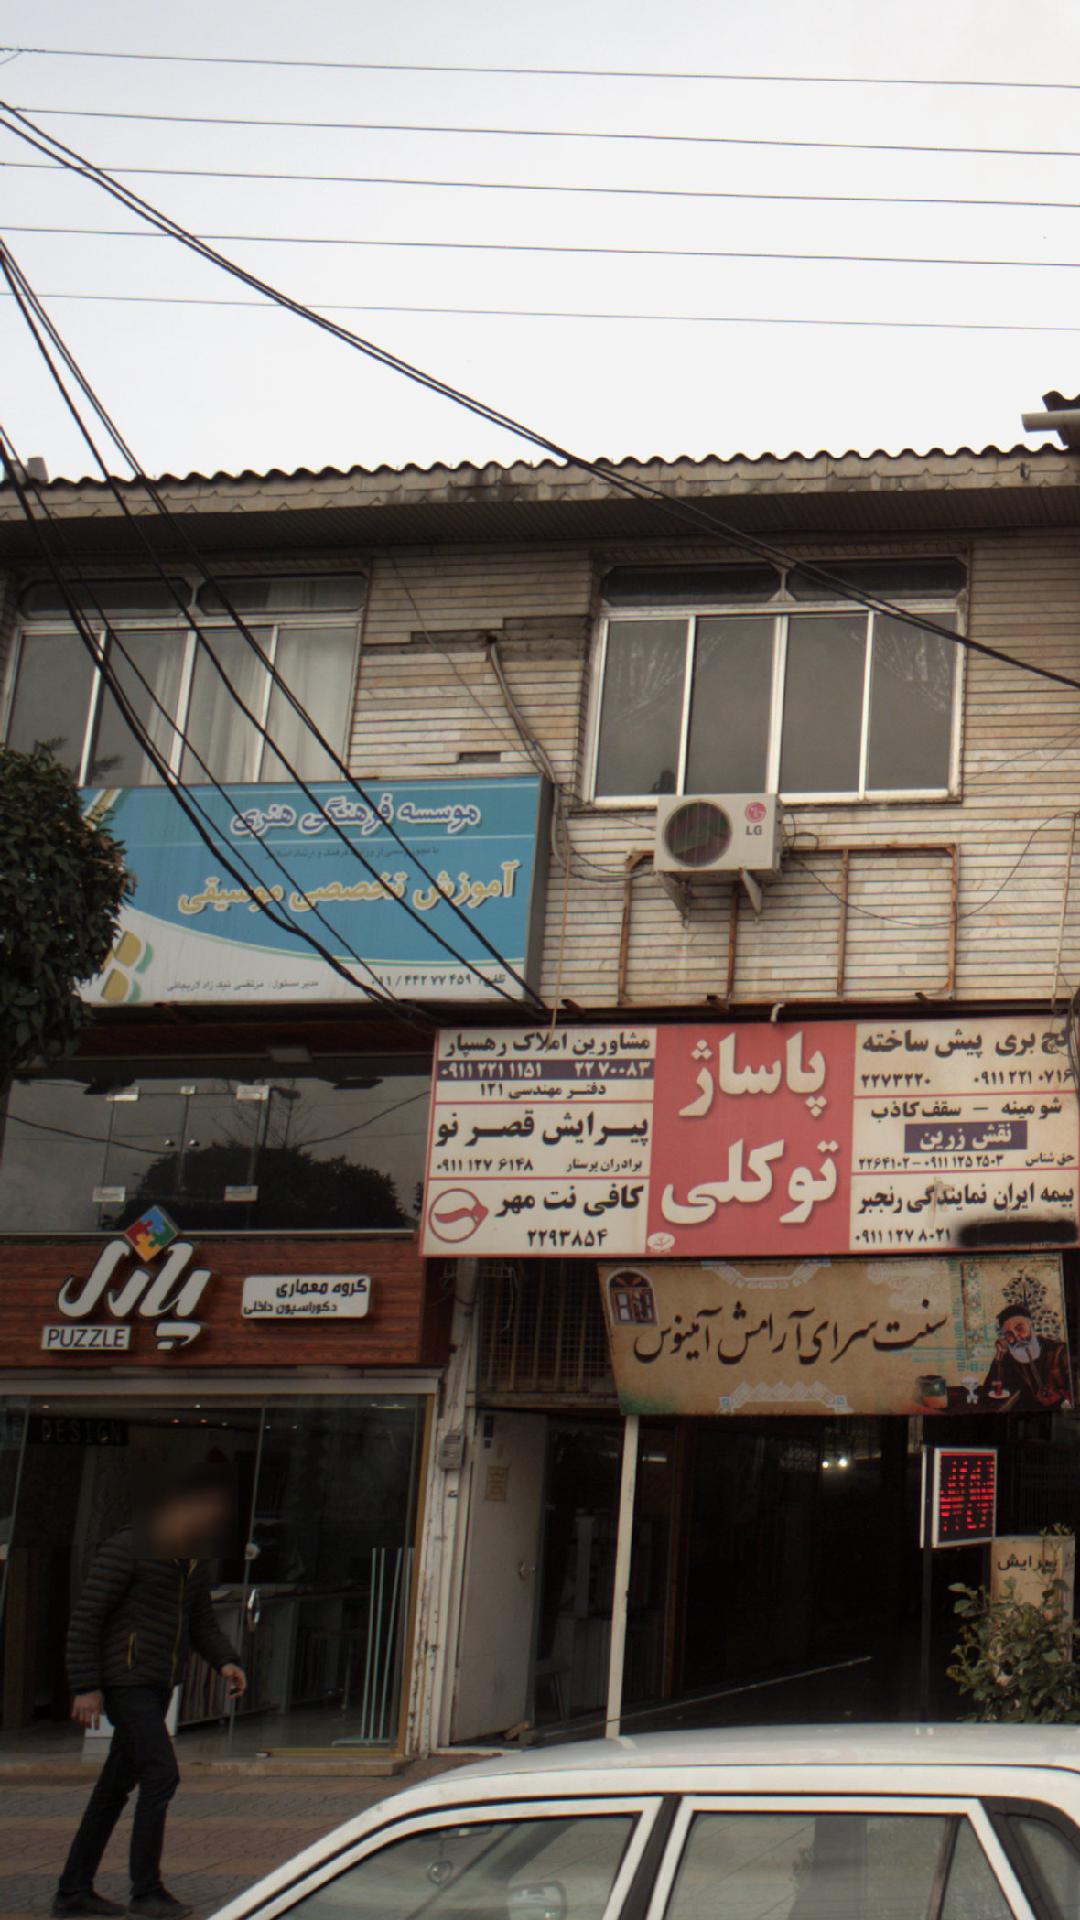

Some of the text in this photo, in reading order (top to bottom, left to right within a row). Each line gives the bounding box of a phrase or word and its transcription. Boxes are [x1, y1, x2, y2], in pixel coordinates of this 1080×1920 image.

[231, 793, 481, 835] موسسه فرهنگی هنری
[745, 825, 762, 836] LG
[178, 861, 520, 912] آموزش تخصصی موسیقی
[445, 1032, 649, 1057] مشاورین املاک رهسپار
[862, 1029, 929, 1053] ساخته
[935, 1029, 983, 1058] پیش
[995, 1033, 1036, 1056] بری
[678, 1031, 828, 1117] پاساژ
[508, 1085, 563, 1099] مهندسی
[567, 1082, 607, 1098] دفتر
[870, 1101, 920, 1123] کاذب
[922, 1101, 961, 1117] سقف
[434, 1109, 649, 1147] پیرایش قصر نو
[919, 1122, 1012, 1151] نقش زرین
[601, 1158, 643, 1173] برادران
[661, 1138, 839, 1225] توکلی
[495, 1183, 644, 1218] کافی نت مهر
[858, 1182, 1074, 1214] بیمه ایران نمایندگی رنجبر
[275, 1278, 367, 1298] گروه معماری
[243, 1300, 338, 1315] دکوراسیون داخلی
[47, 1328, 126, 1348] PUZZLE
[718, 1301, 816, 1365] آرامش
